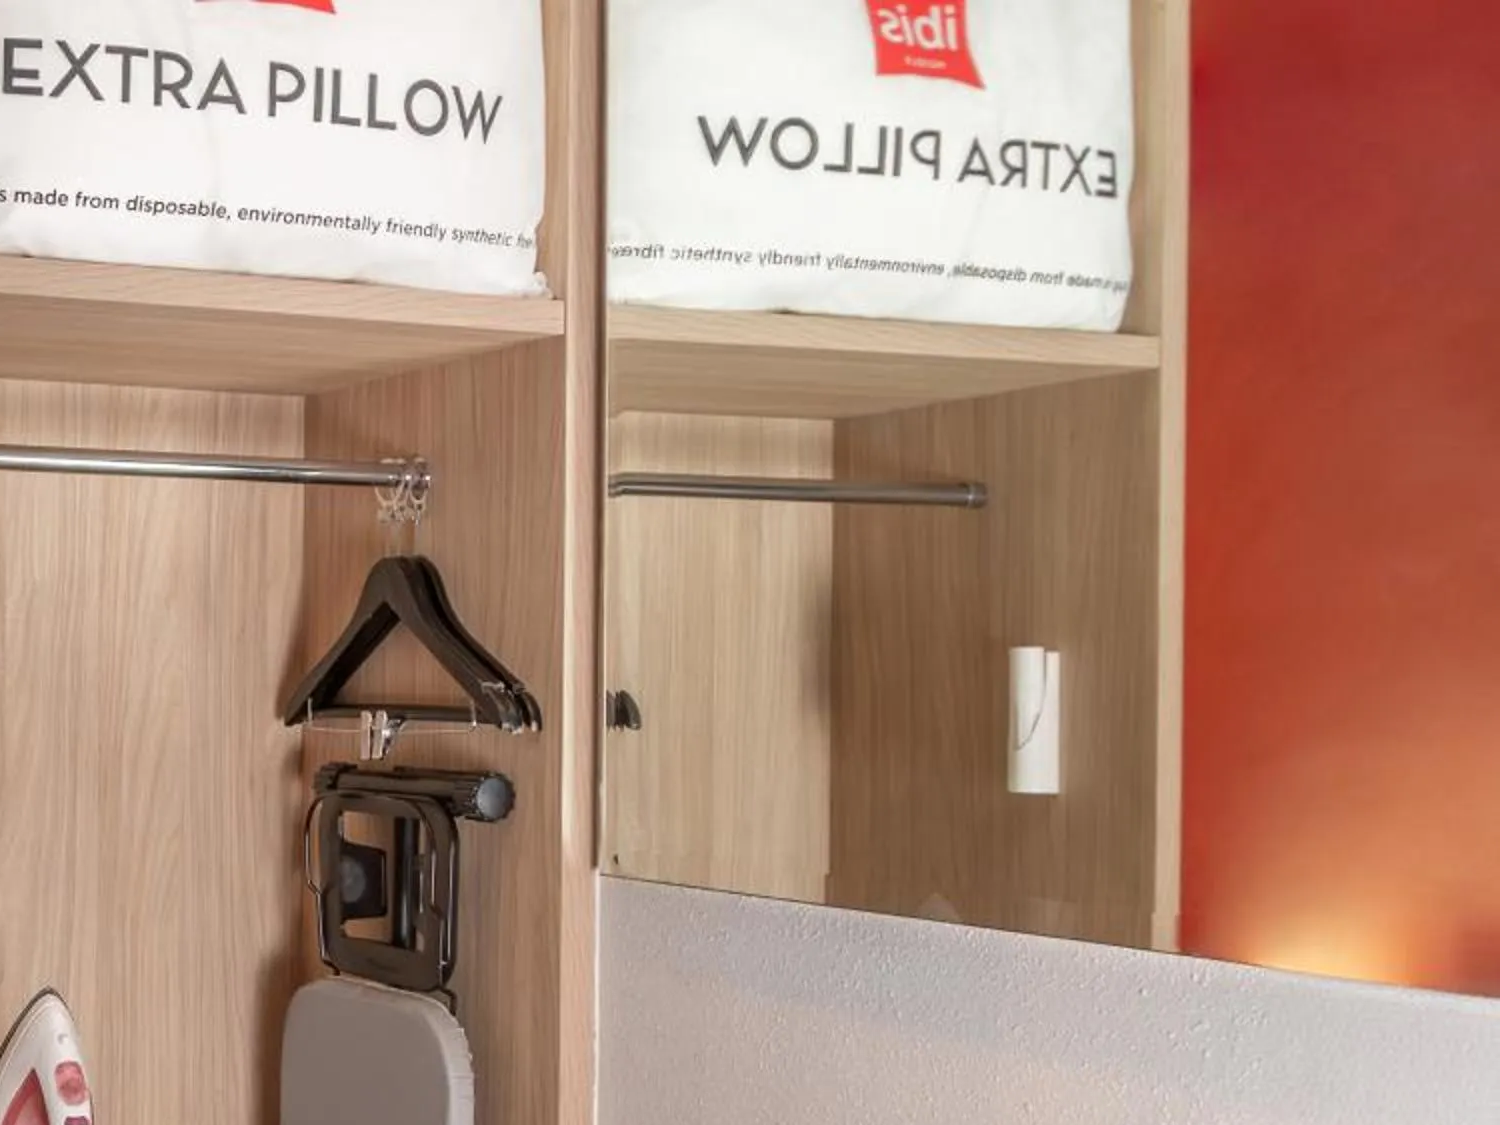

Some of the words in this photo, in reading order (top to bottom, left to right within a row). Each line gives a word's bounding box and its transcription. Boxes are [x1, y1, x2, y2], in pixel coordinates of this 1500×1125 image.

[1, 37, 247, 115] EXTRA
[267, 61, 503, 145] PILLOW
[13, 188, 69, 208] made
[75, 190, 120, 210] from
[125, 194, 231, 221] disposable,
[237, 207, 382, 236] environmentally
[385, 217, 447, 242] friendly
[451, 227, 513, 247] synthetic
